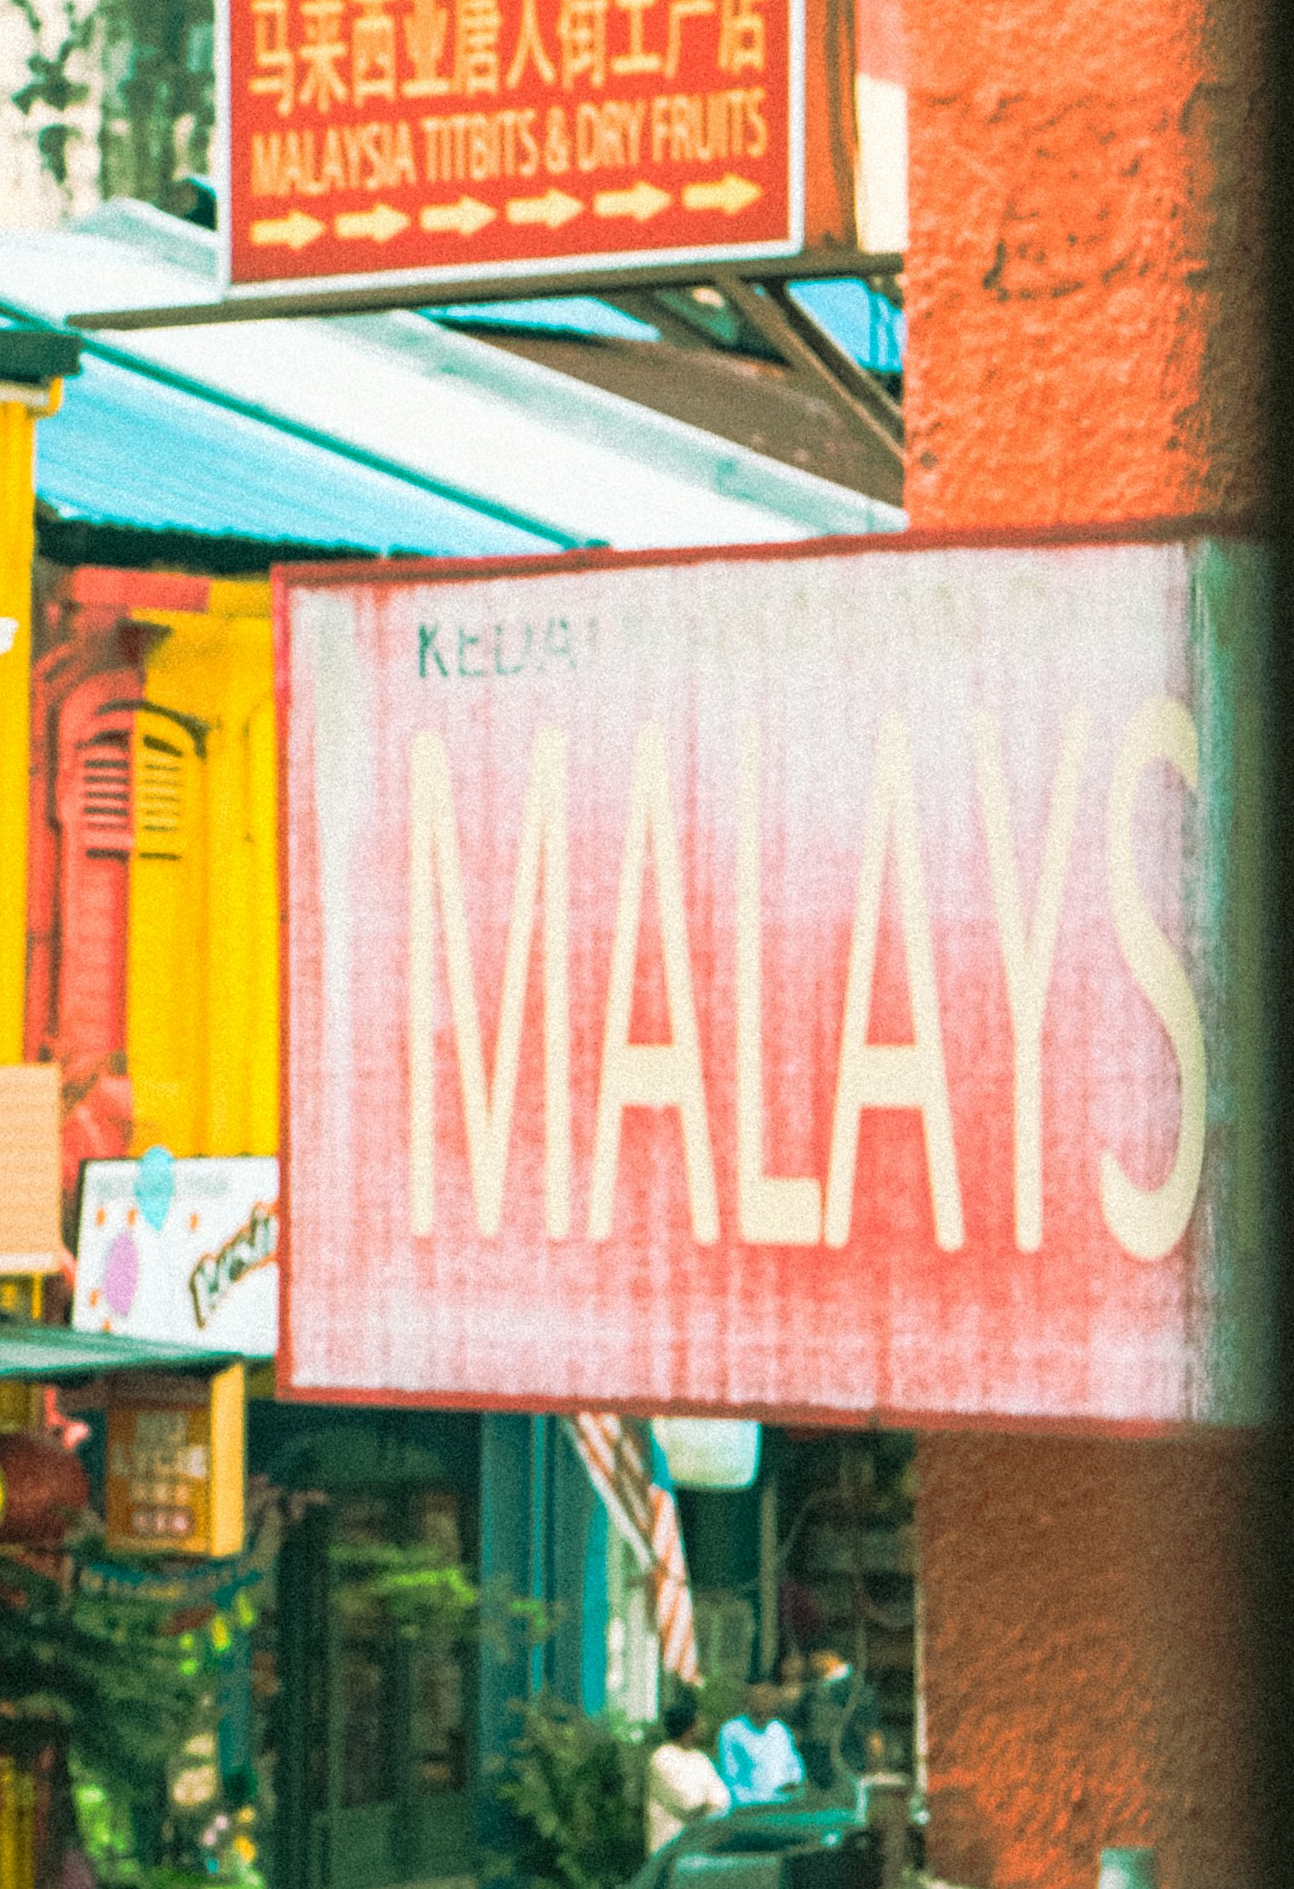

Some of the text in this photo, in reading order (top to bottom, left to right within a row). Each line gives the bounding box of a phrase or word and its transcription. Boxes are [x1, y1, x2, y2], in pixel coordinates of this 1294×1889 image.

[250, 87, 768, 197] MALAYSIA TITBITS & DRY FRUITS
